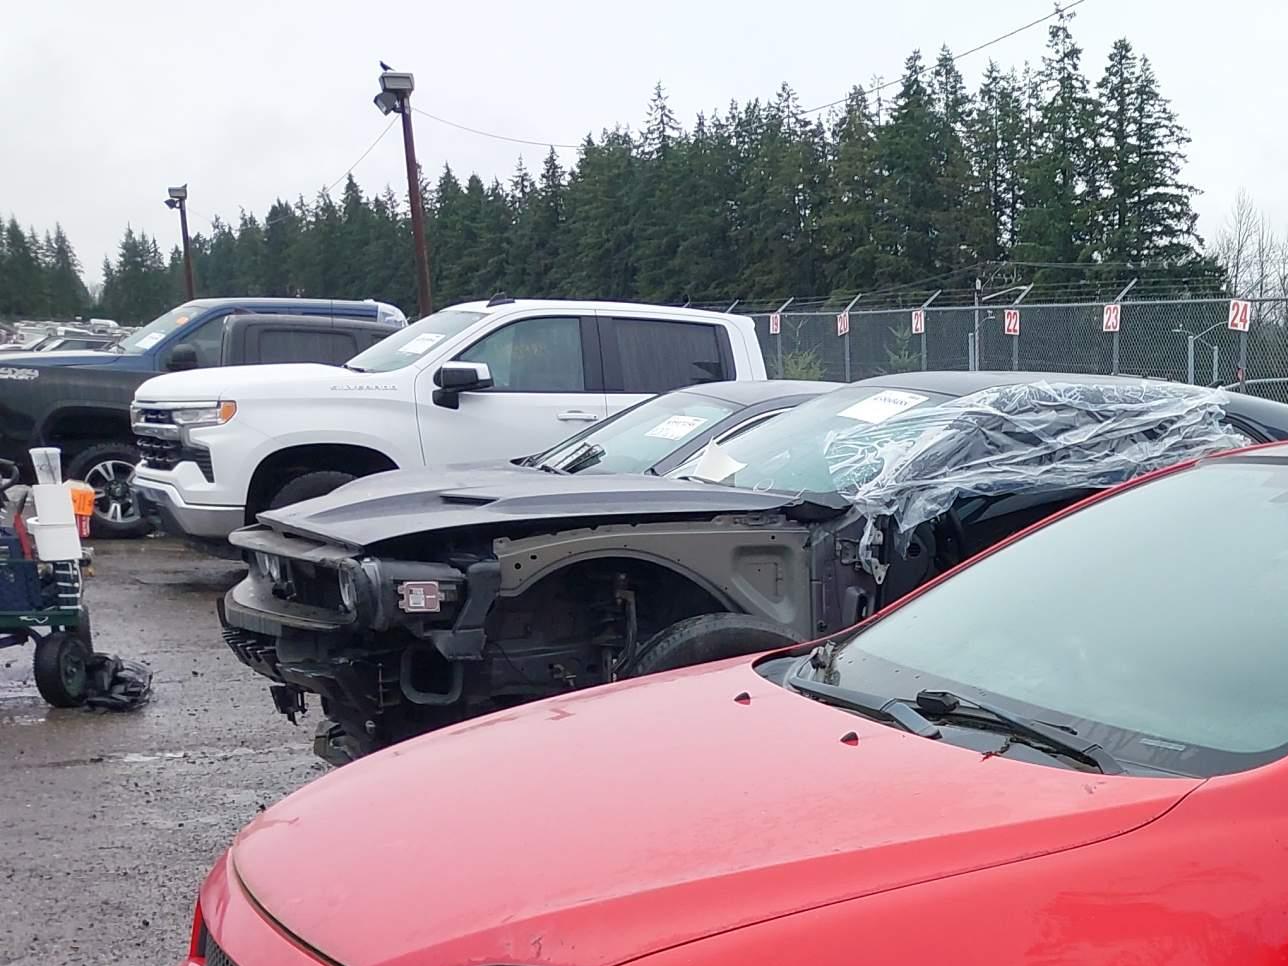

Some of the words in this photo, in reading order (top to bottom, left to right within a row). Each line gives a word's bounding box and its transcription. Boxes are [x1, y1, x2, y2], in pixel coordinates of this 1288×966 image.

[772, 314, 778, 332] 19
[838, 315, 847, 333] 20
[914, 312, 923, 333] 21
[1006, 312, 1018, 333] 22
[1105, 306, 1119, 330] 23
[1231, 302, 1248, 329] 24
